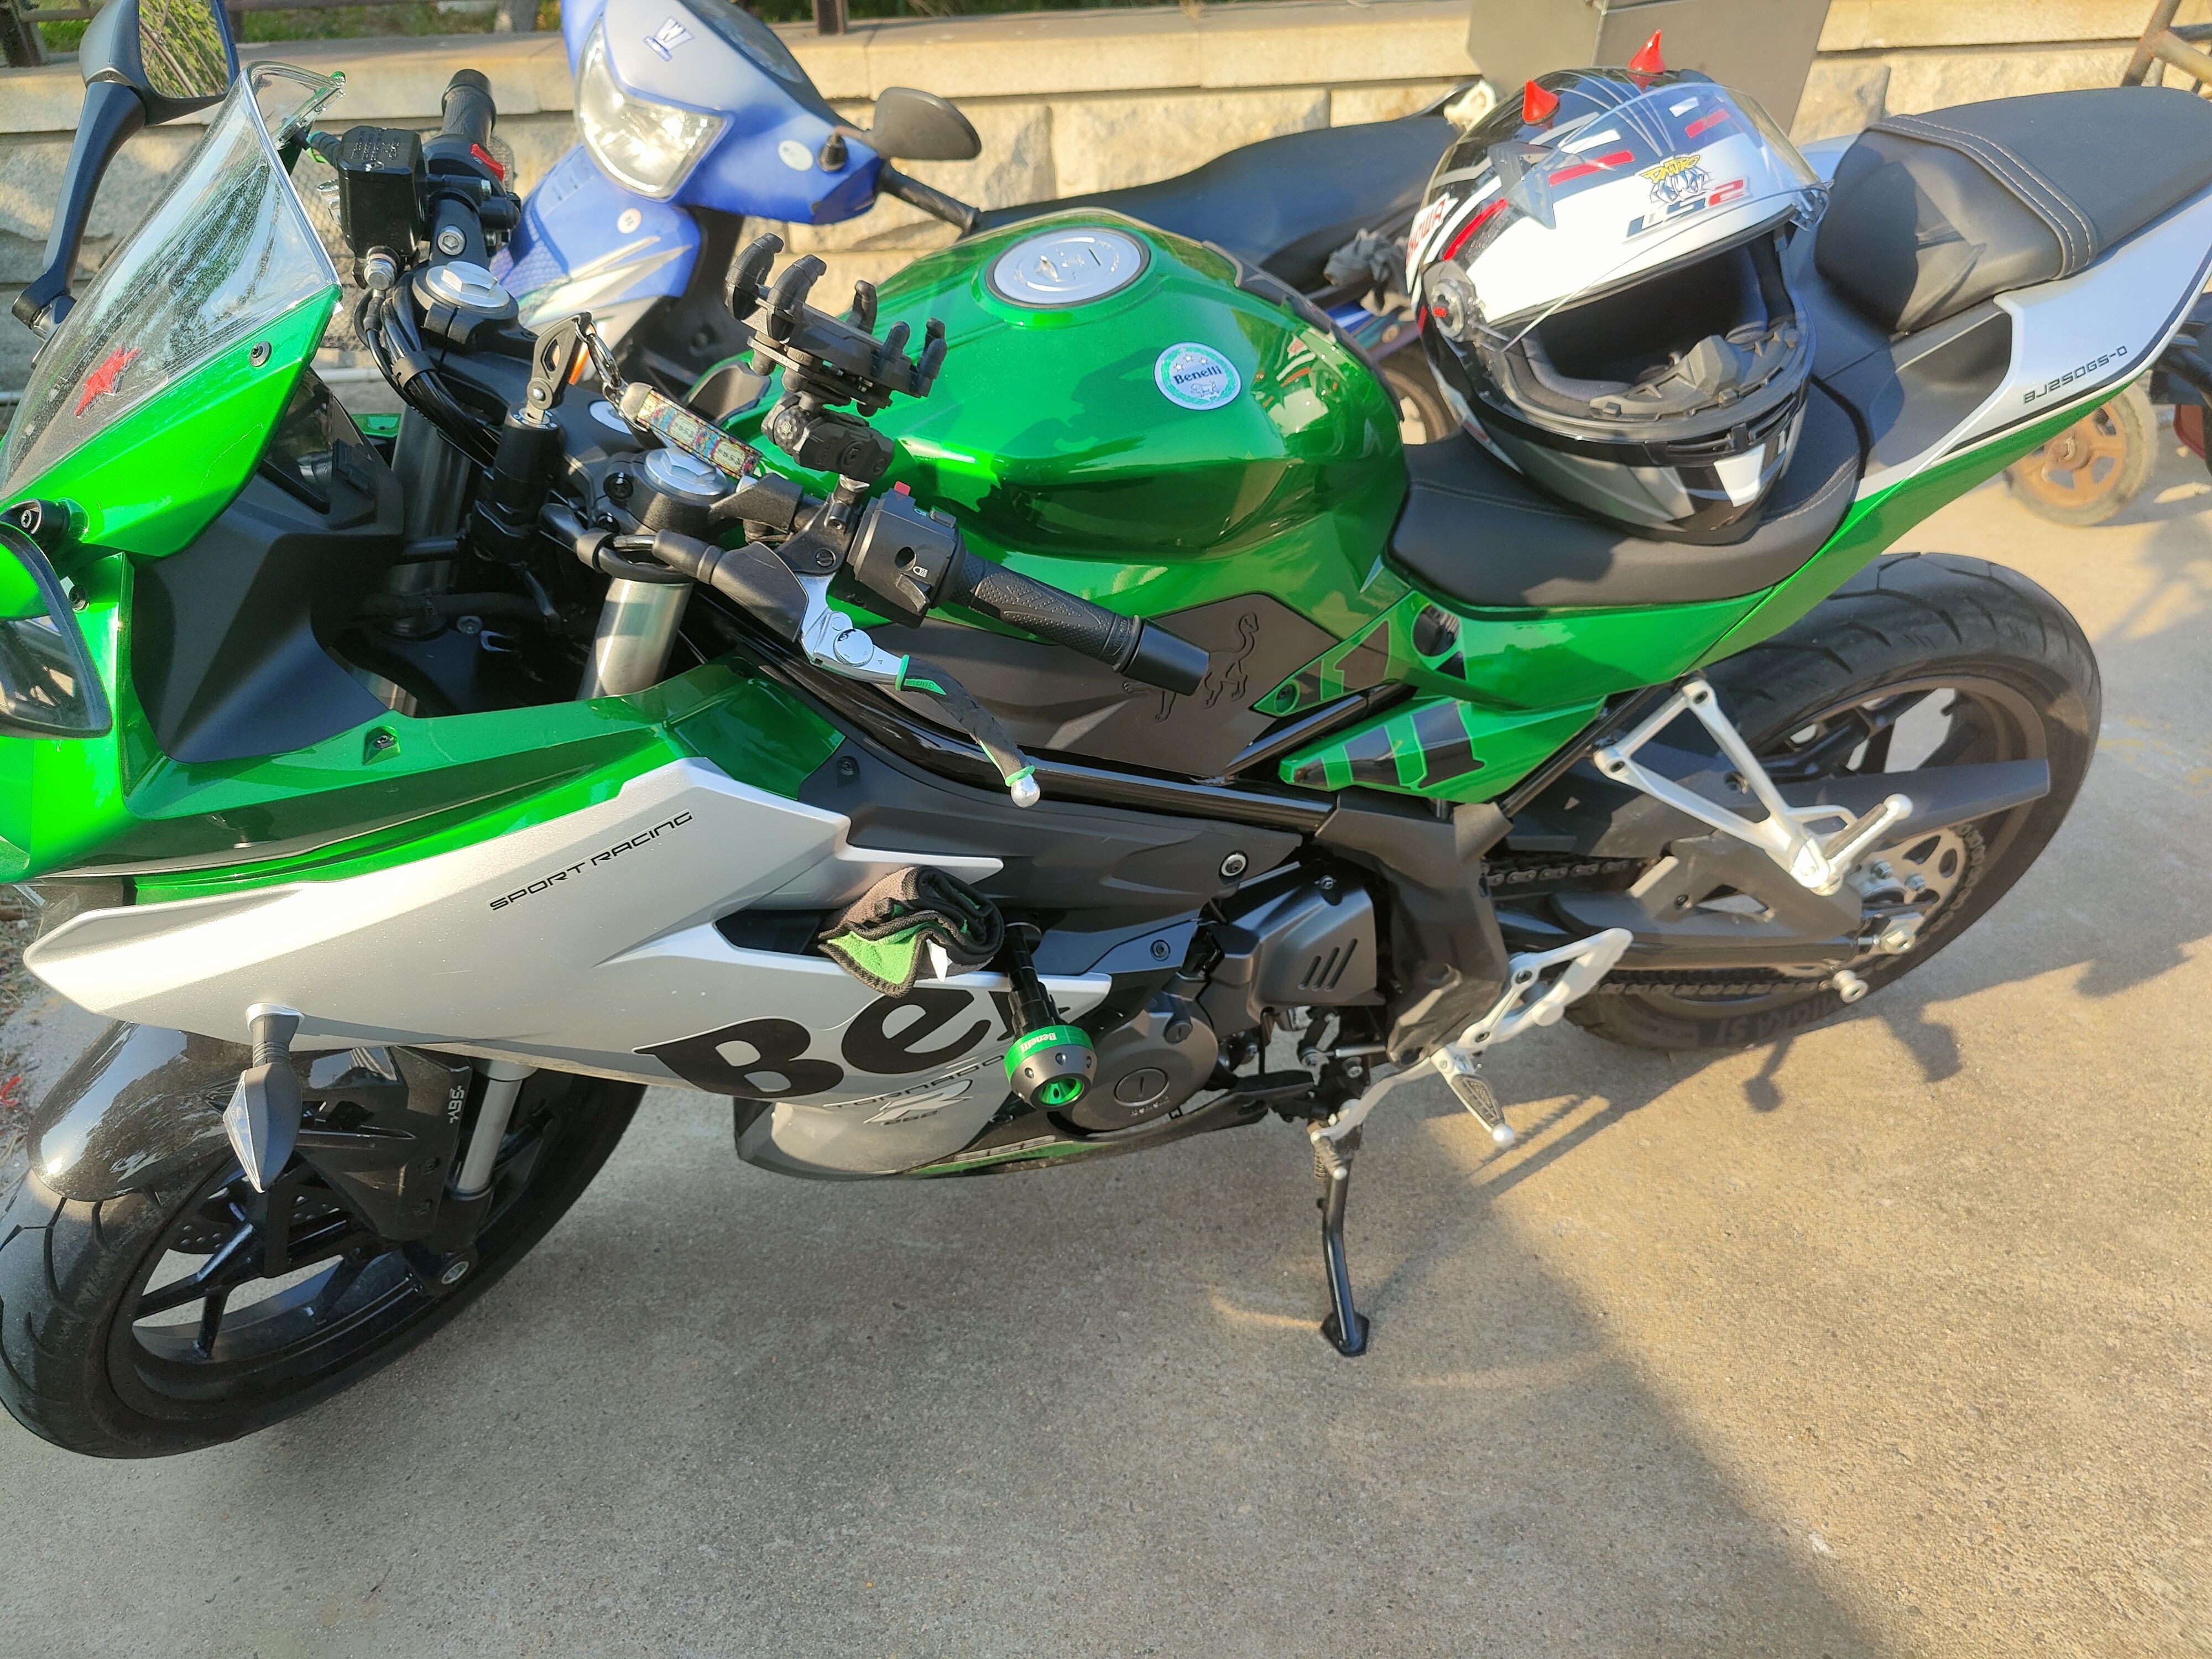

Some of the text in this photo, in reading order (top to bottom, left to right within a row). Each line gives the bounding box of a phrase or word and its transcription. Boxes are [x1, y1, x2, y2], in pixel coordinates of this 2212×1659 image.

[1173, 365, 1223, 385] Benelli
[489, 811, 692, 911] SPORT RACING
[1020, 1031, 1057, 1053] Benelli
